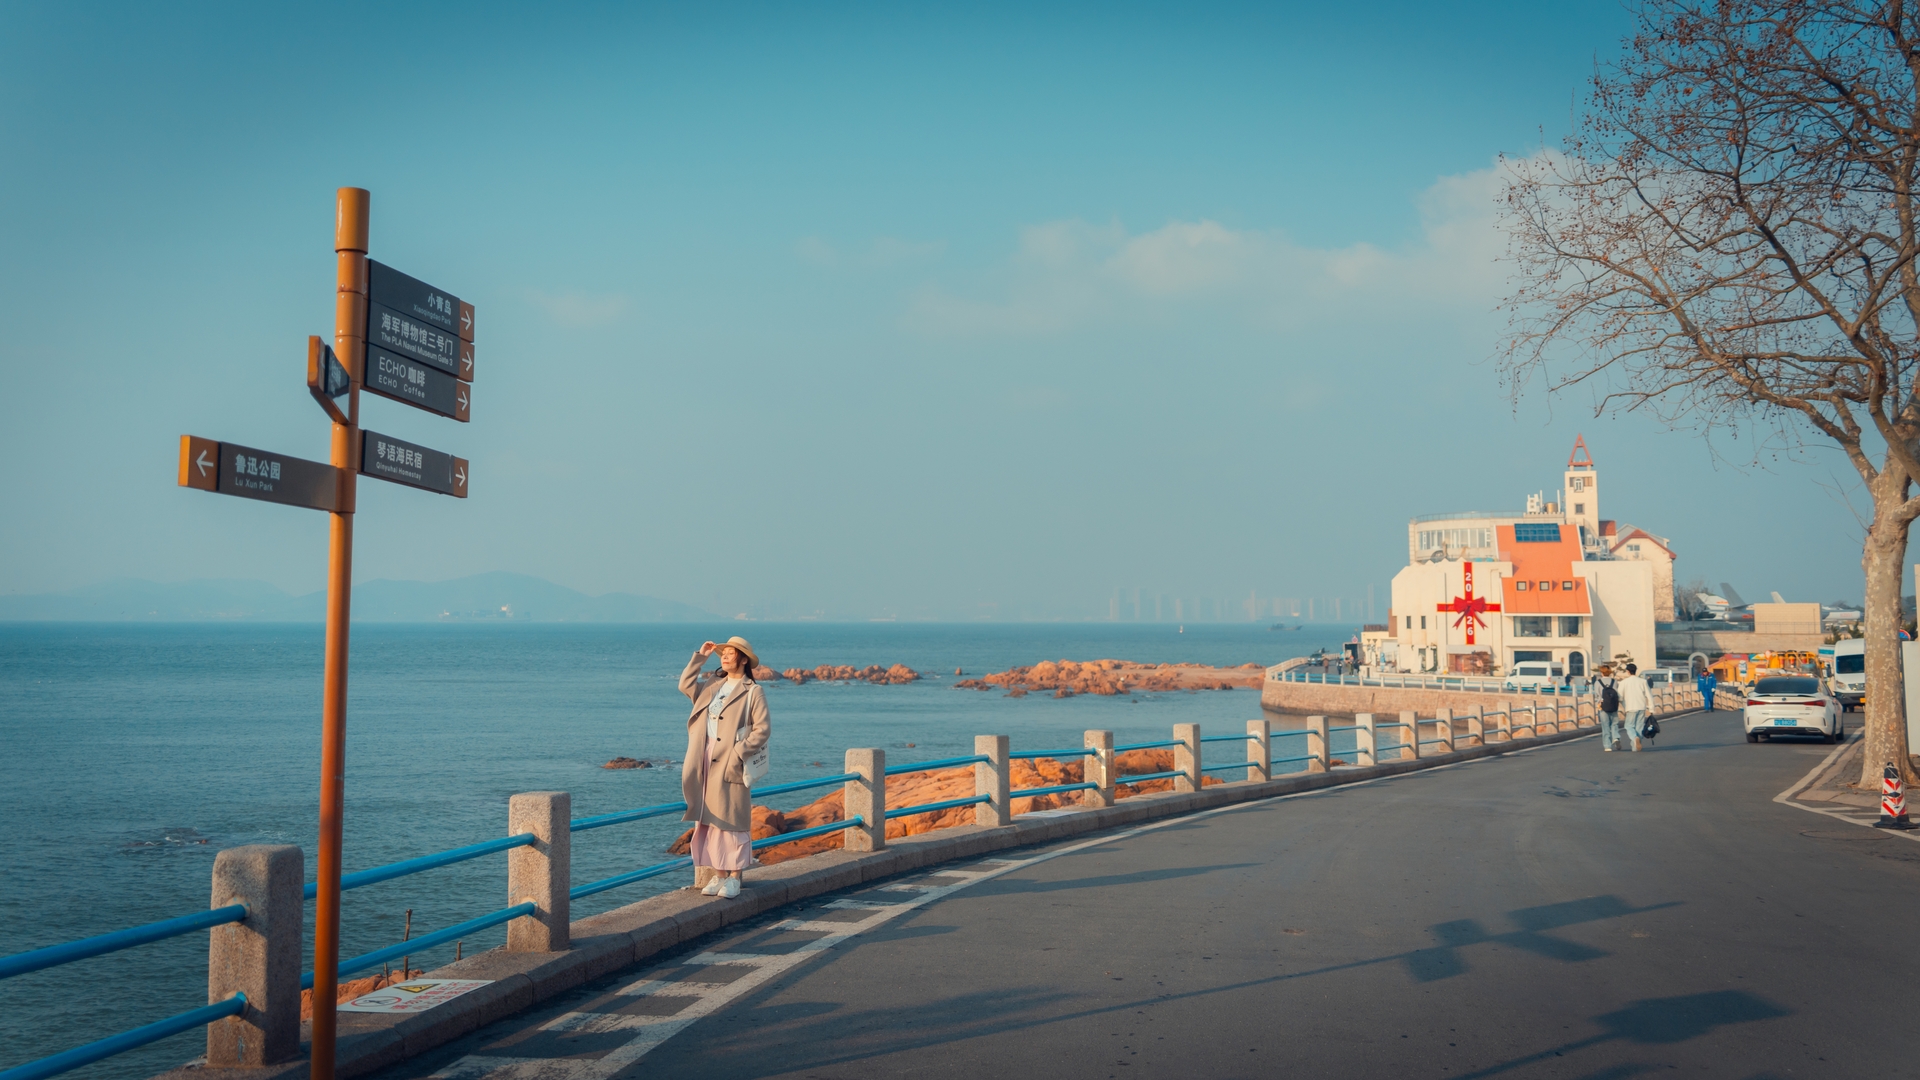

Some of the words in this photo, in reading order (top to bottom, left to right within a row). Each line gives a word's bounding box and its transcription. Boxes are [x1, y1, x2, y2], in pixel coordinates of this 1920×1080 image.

[413, 303, 441, 321] Xiaoqingdao
[441, 315, 452, 326] Park
[427, 292, 452, 316] 小青岛
[381, 312, 453, 356] 海军博物馆三号门
[381, 331, 391, 343] The
[391, 335, 402, 347] PLA
[402, 340, 417, 353] Naval
[417, 345, 437, 361] Museum
[437, 353, 449, 365] Gate
[449, 358, 453, 367] 3
[379, 356, 407, 378] ECHO
[407, 366, 426, 387] 咖啡
[378, 374, 398, 388] ECHO
[403, 383, 426, 398] Coffee
[234, 453, 281, 480] 鲁迅公园
[377, 440, 423, 470] 琴语海民宿
[375, 461, 398, 474] Qinyuhai
[398, 467, 422, 481] Homestay
[234, 476, 244, 487] Lu
[244, 478, 258, 489] Xun
[258, 480, 274, 492] Park
